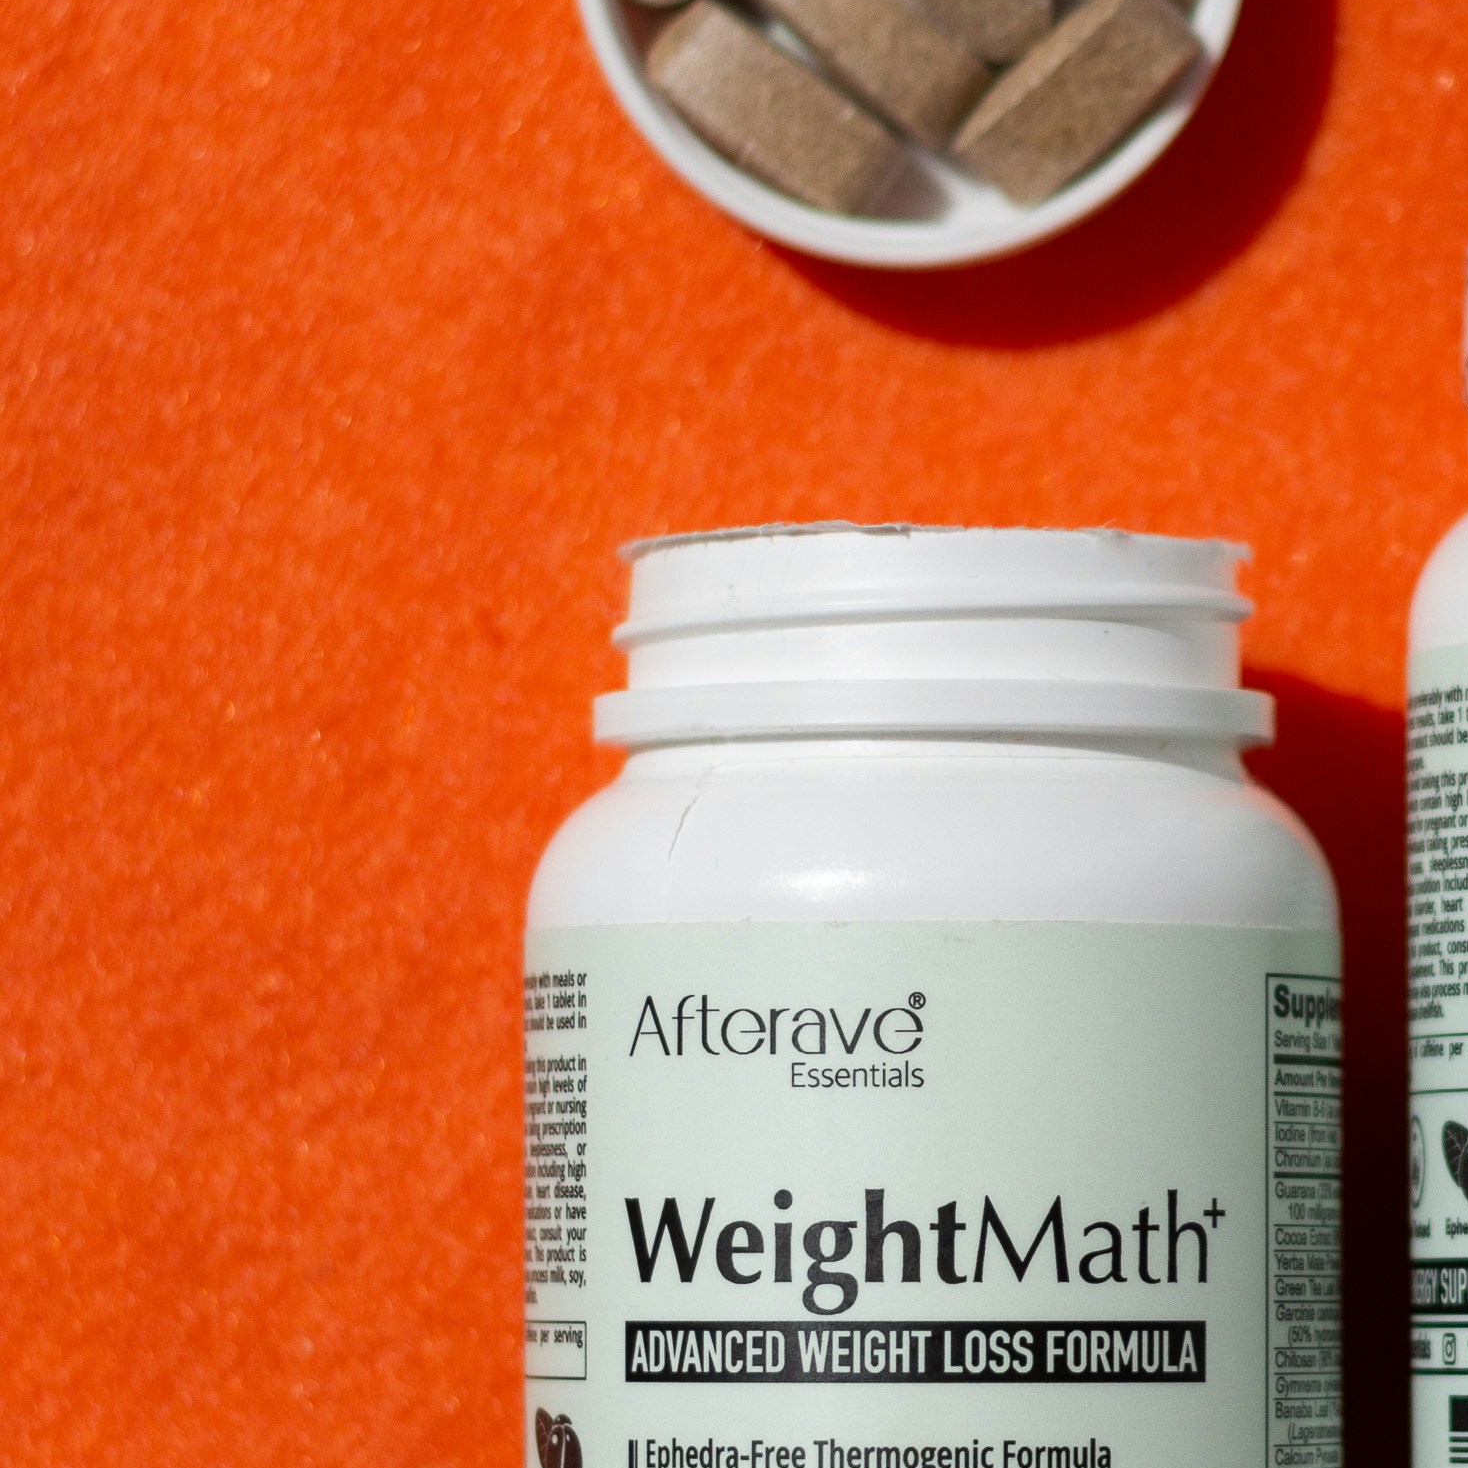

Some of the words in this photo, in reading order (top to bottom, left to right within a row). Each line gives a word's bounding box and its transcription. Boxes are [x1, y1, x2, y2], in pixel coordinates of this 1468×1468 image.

[1437, 707, 1455, 725] take
[1457, 707, 1462, 722] 1
[1456, 727, 1468, 744] be
[1444, 790, 1463, 812] high
[1457, 814, 1468, 828] or
[1440, 896, 1463, 913] heart
[552, 969, 575, 987] meals
[576, 972, 587, 986] or
[552, 992, 576, 1009] tablet
[578, 990, 587, 1008] in
[556, 1011, 575, 1029] used
[578, 1011, 587, 1029] in
[1274, 1029, 1311, 1052] Serving
[1448, 1041, 1464, 1061] per
[547, 1054, 576, 1078] product
[578, 1054, 587, 1071] in
[791, 1060, 925, 1089] Essentials
[552, 1075, 574, 1093] levels
[577, 1075, 588, 1093] of
[1274, 1068, 1314, 1087] Amount
[555, 1096, 587, 1118] nursing
[1274, 1099, 1311, 1117] Vitamin
[542, 1118, 587, 1140] prescription
[1275, 1125, 1306, 1142] Iodine
[576, 1142, 587, 1156] or
[567, 1159, 587, 1182] high
[554, 1182, 587, 1201] disease,
[554, 1205, 563, 1220] or
[565, 1202, 587, 1220] have
[1288, 1202, 1306, 1220] 100
[566, 1227, 587, 1245] your
[1274, 1228, 1307, 1246] Cocoa
[546, 1245, 575, 1265] product
[579, 1244, 587, 1262] is
[569, 1269, 587, 1288] soy,
[1275, 1278, 1306, 1296] Green
[1275, 1303, 1315, 1322] Garcinia
[553, 1325, 583, 1349] serving
[631, 1329, 786, 1374] ADVANCED
[797, 1329, 932, 1374] WEIGHT
[943, 1329, 1034, 1374] LOSS
[1046, 1329, 1197, 1374] FORMULA
[1274, 1448, 1314, 1465] Calcium
